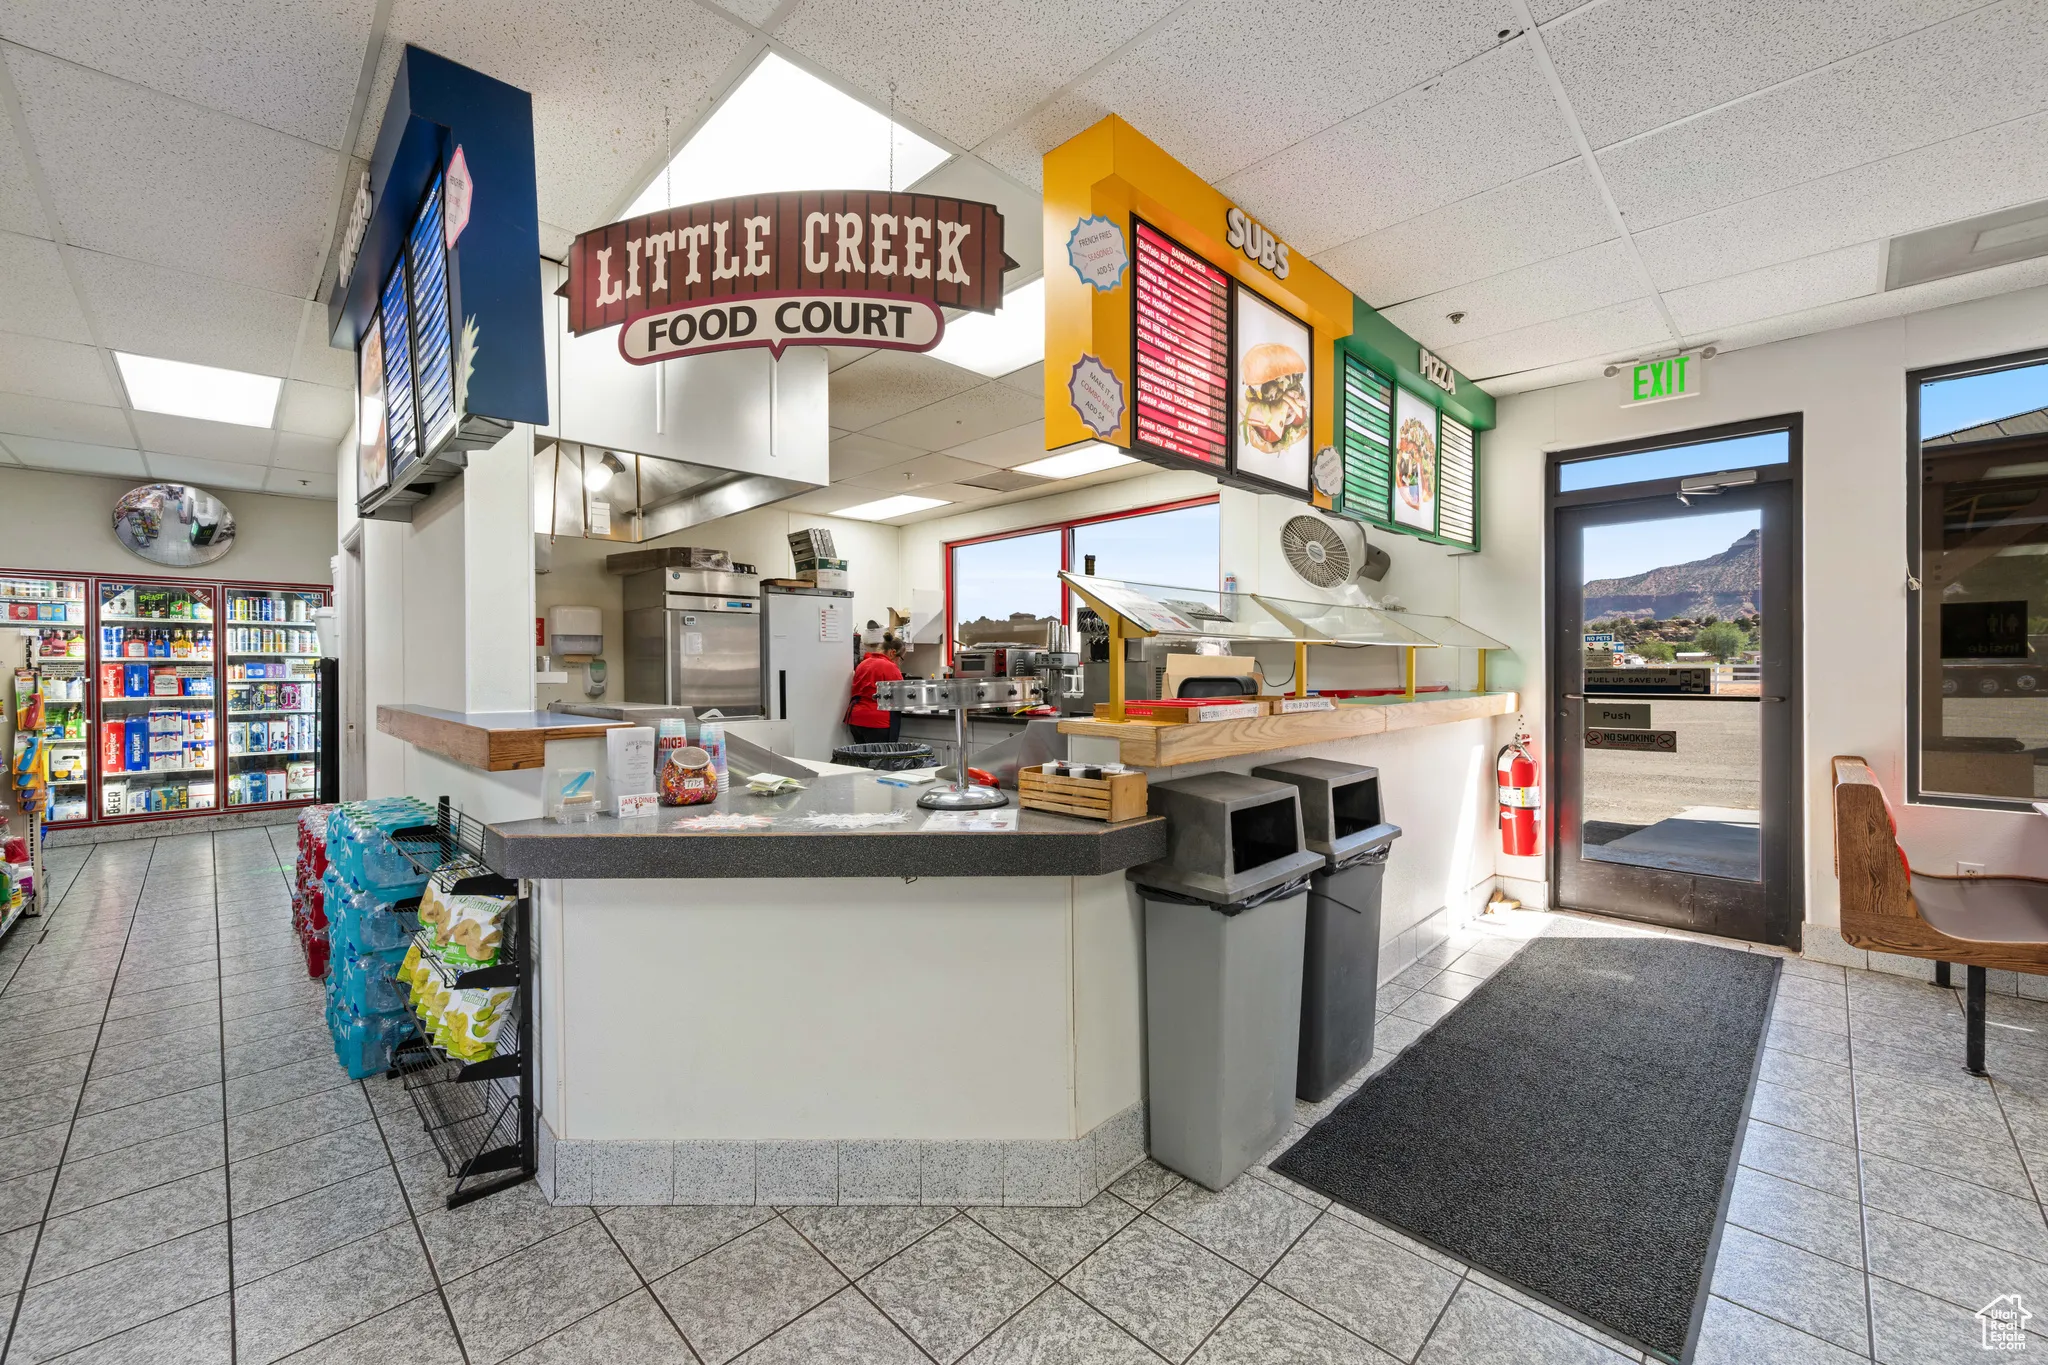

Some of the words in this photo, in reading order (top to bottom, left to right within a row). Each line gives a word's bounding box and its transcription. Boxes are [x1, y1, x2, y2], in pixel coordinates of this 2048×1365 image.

[1079, 234, 1099, 248] FRENCH
[1098, 230, 1112, 240] FRIES
[1226, 207, 1290, 280] SUBS
[596, 215, 771, 308] LITTLE
[803, 212, 971, 286] CREEK
[1087, 246, 1114, 262] SEASONED
[1139, 239, 1159, 258] Buffalo
[1160, 253, 1169, 264] Bill
[1170, 259, 1184, 274] Cody
[1139, 252, 1165, 274] Geronimo
[1171, 247, 1206, 273] SANDWICHES
[1097, 265, 1107, 276] ADD
[1107, 263, 1115, 272] $1
[1139, 265, 1157, 283] Sitting
[1158, 276, 1168, 289] Bull
[1139, 277, 1151, 291] Billy
[1152, 285, 1161, 296] the
[1162, 291, 1172, 302] Kid
[1140, 289, 1151, 303] Doc
[1140, 303, 1155, 317] Wyatt
[648, 305, 758, 352] FOOD
[774, 301, 912, 339] COURT
[1140, 316, 1151, 329] Wild
[1152, 323, 1161, 333] Bill
[1155, 337, 1171, 352] Horse
[1140, 354, 1155, 367] Butch
[1155, 361, 1177, 378] Cassidy
[1164, 353, 1175, 366] HOT
[1177, 360, 1211, 381] SANDWICHES
[1419, 348, 1456, 395] PIZZA
[1140, 367, 1166, 386] Sundance
[1633, 356, 1690, 400] EXIT
[1089, 372, 1106, 391] MAKE
[1104, 388, 1111, 396] IT
[1110, 394, 1115, 402] A
[1140, 381, 1153, 392] RED
[1153, 386, 1173, 401] CLOUD
[1173, 394, 1188, 407] TACO
[1080, 379, 1102, 402] COMBO
[1101, 400, 1115, 418] MEAL
[1085, 400, 1098, 415] ADD
[1141, 394, 1157, 406] Jesse
[1158, 401, 1175, 414] James
[1140, 418, 1155, 431] Annie
[1156, 424, 1174, 438] Oakley
[1177, 420, 1199, 435] SALADS
[1140, 430, 1163, 447] Calamity
[1164, 439, 1177, 451] Jane
[139, 593, 166, 601] BEAST
[1201, 710, 1220, 719] RETURN
[1603, 711, 1631, 720] Push
[1603, 733, 1616, 741] NO
[1617, 733, 1656, 743] SMOKING
[108, 791, 121, 814] BEER
[621, 797, 638, 806] JAN'S
[639, 796, 656, 804] DINER
